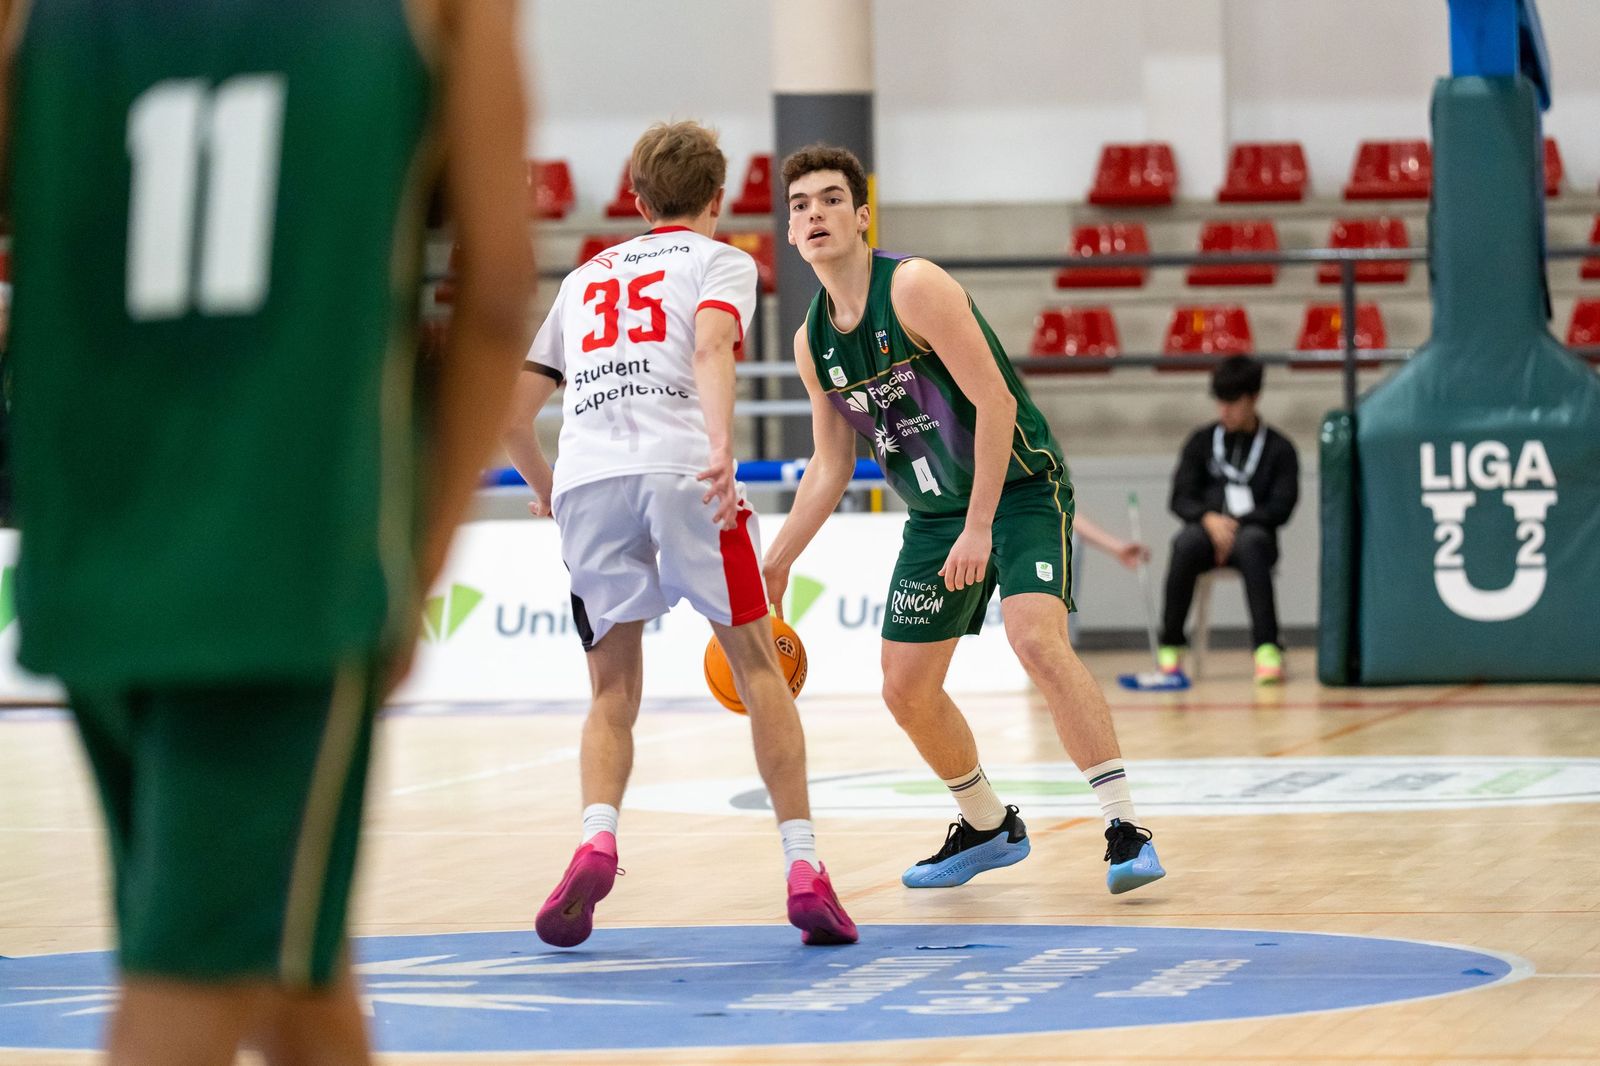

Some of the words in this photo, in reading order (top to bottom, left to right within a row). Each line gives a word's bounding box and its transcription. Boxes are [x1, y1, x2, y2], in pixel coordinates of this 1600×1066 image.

[126, 74, 287, 319] 11
[623, 245, 690, 264] lapalma
[582, 270, 667, 352] 35
[575, 359, 650, 391] Student
[575, 382, 689, 415] Experience
[901, 428, 912, 437] de
[911, 425, 919, 434] la
[918, 420, 940, 431] Torre
[911, 456, 942, 497] 4
[1419, 440, 1558, 490] LIGA
[900, 579, 938, 591] CLINICAS
[892, 615, 931, 625] DENTAL
[952, 947, 1138, 980] Torre
